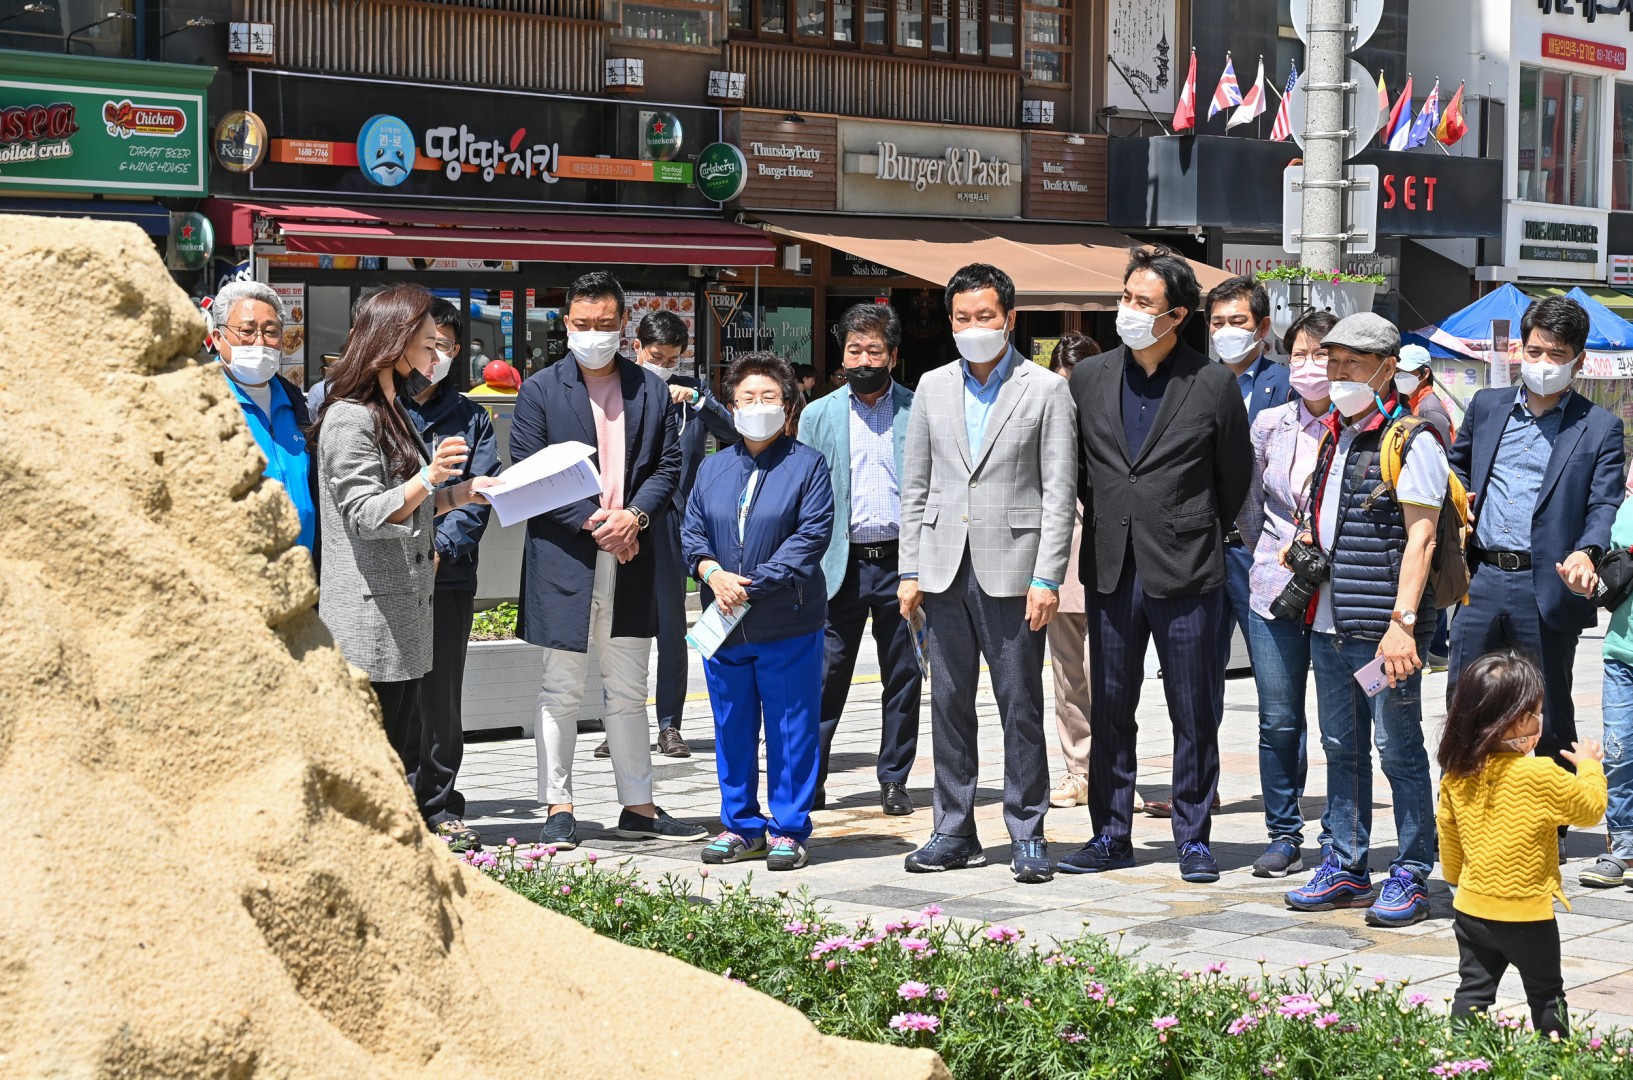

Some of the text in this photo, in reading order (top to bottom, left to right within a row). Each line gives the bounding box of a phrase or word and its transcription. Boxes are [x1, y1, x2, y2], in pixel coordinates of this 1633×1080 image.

[0, 103, 79, 141] sea
[135, 111, 175, 126] Chicken
[38, 139, 71, 158] crab
[129, 145, 191, 159] DRAFT BEER
[221, 143, 253, 159] Kozel
[425, 124, 560, 184] 땅땅치킨
[129, 161, 157, 172] WINE
[157, 161, 191, 174] HOUSE
[700, 159, 735, 180] Carlsberg
[757, 163, 814, 180] Burger House
[876, 141, 1011, 192] Burger & Pasta
[1042, 161, 1065, 174] Music
[1522, 219, 1599, 244] DREAMCATCHER
[852, 264, 888, 276] Slash Store
[708, 293, 737, 308] TERRA
[782, 321, 812, 338] Party
